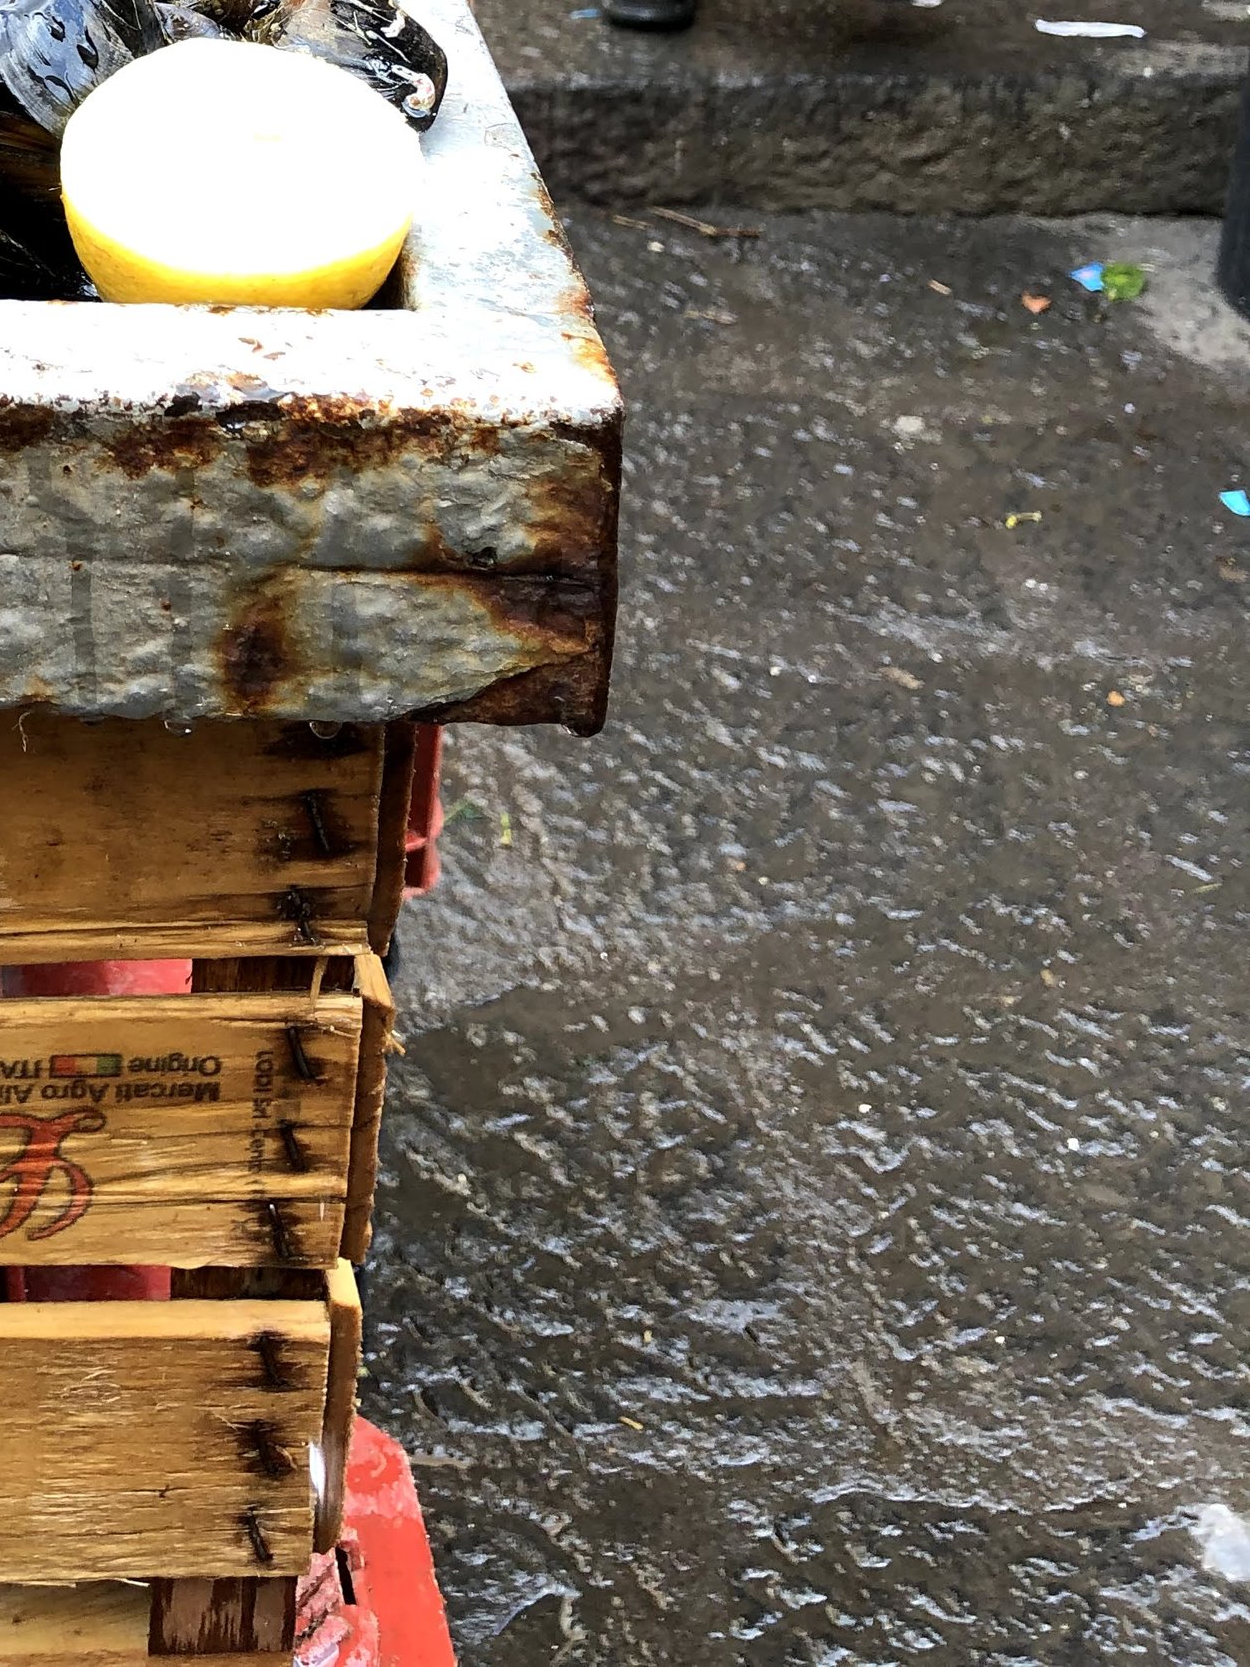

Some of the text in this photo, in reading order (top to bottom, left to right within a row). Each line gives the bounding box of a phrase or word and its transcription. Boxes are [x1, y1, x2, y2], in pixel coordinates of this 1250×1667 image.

[128, 1055, 222, 1077] Origine
[41, 1079, 110, 1103] Agro
[115, 1082, 221, 1103] Mercati
